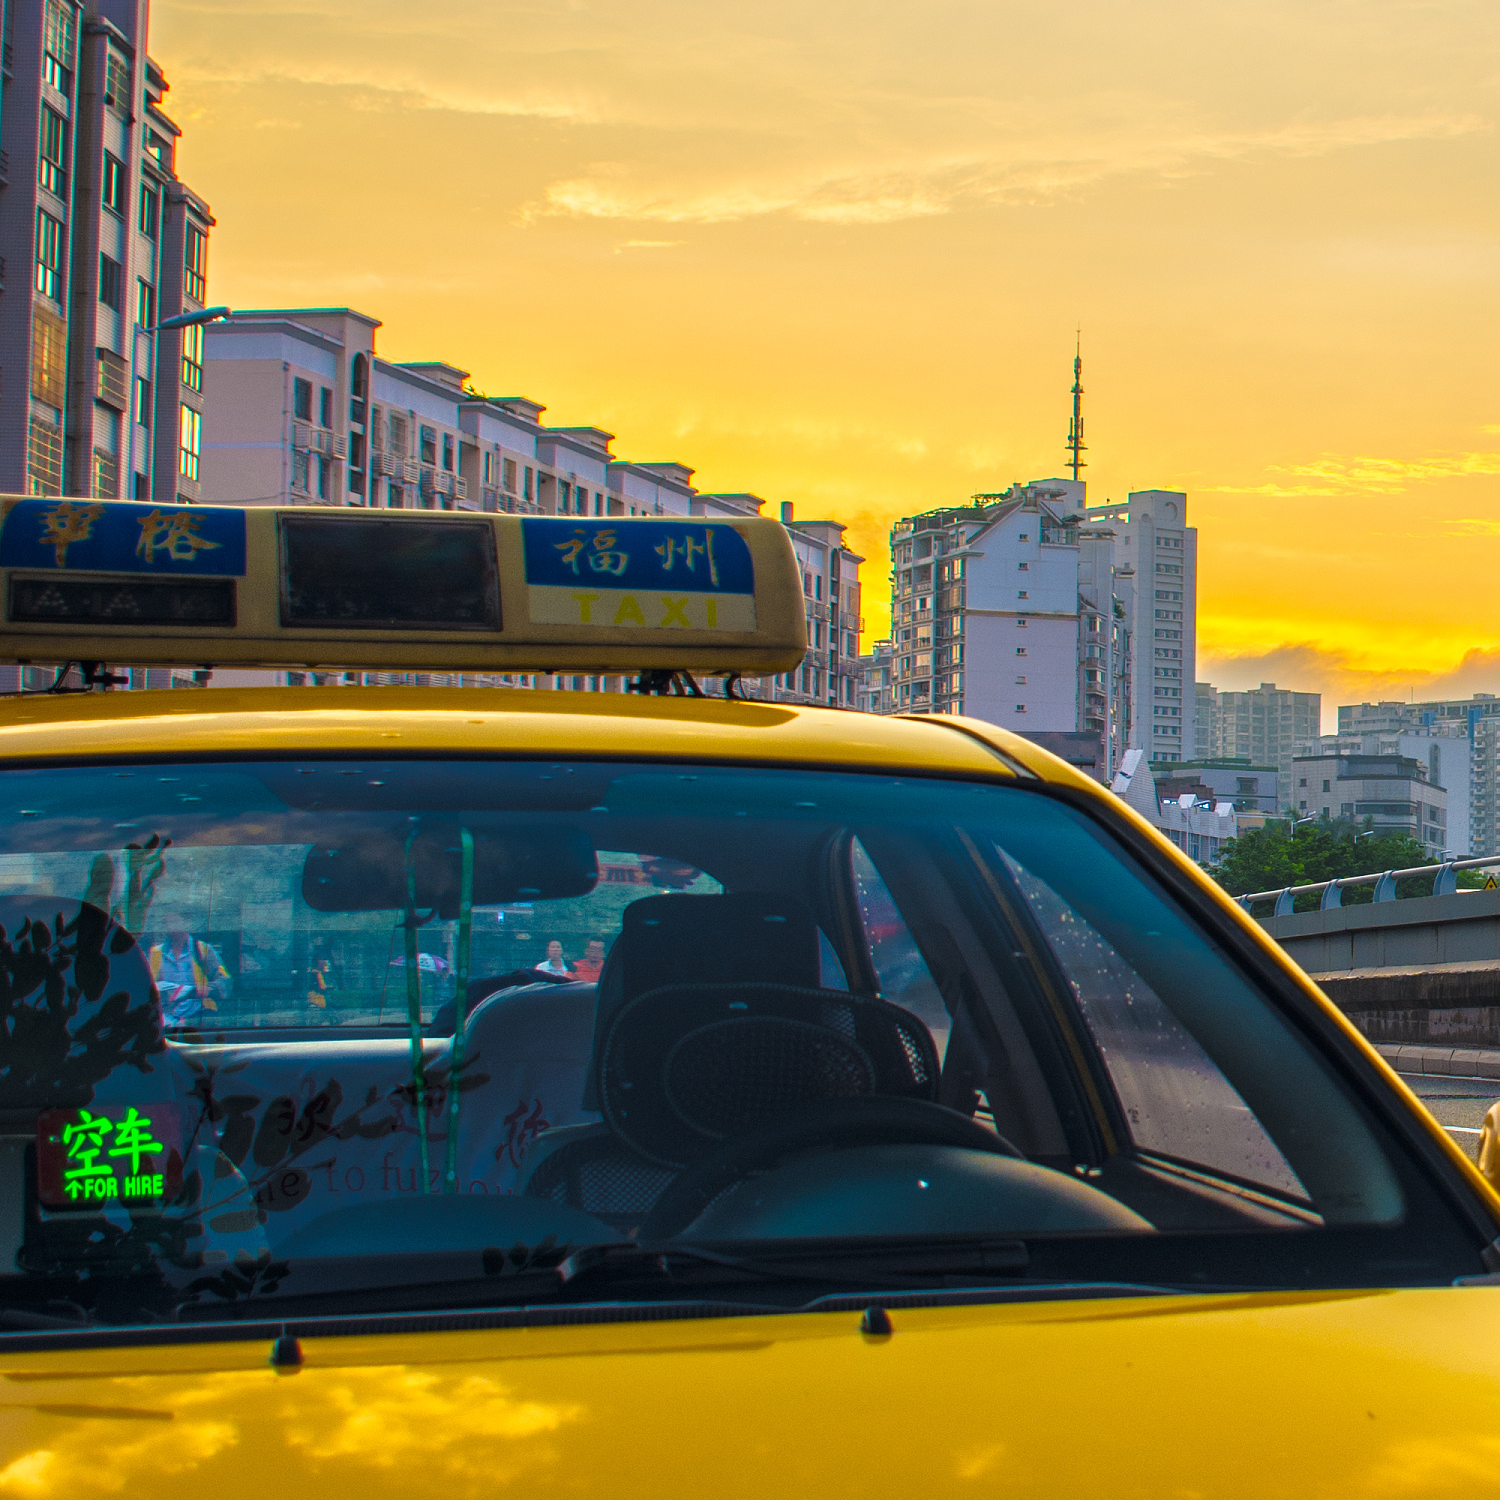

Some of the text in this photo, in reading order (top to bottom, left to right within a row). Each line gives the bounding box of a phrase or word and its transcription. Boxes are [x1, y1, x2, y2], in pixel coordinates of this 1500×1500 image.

[554, 526, 721, 588] 福州
[572, 593, 719, 630] TAXI
[63, 1107, 163, 1179] 空车
[84, 1174, 163, 1199] FOR HIRE
